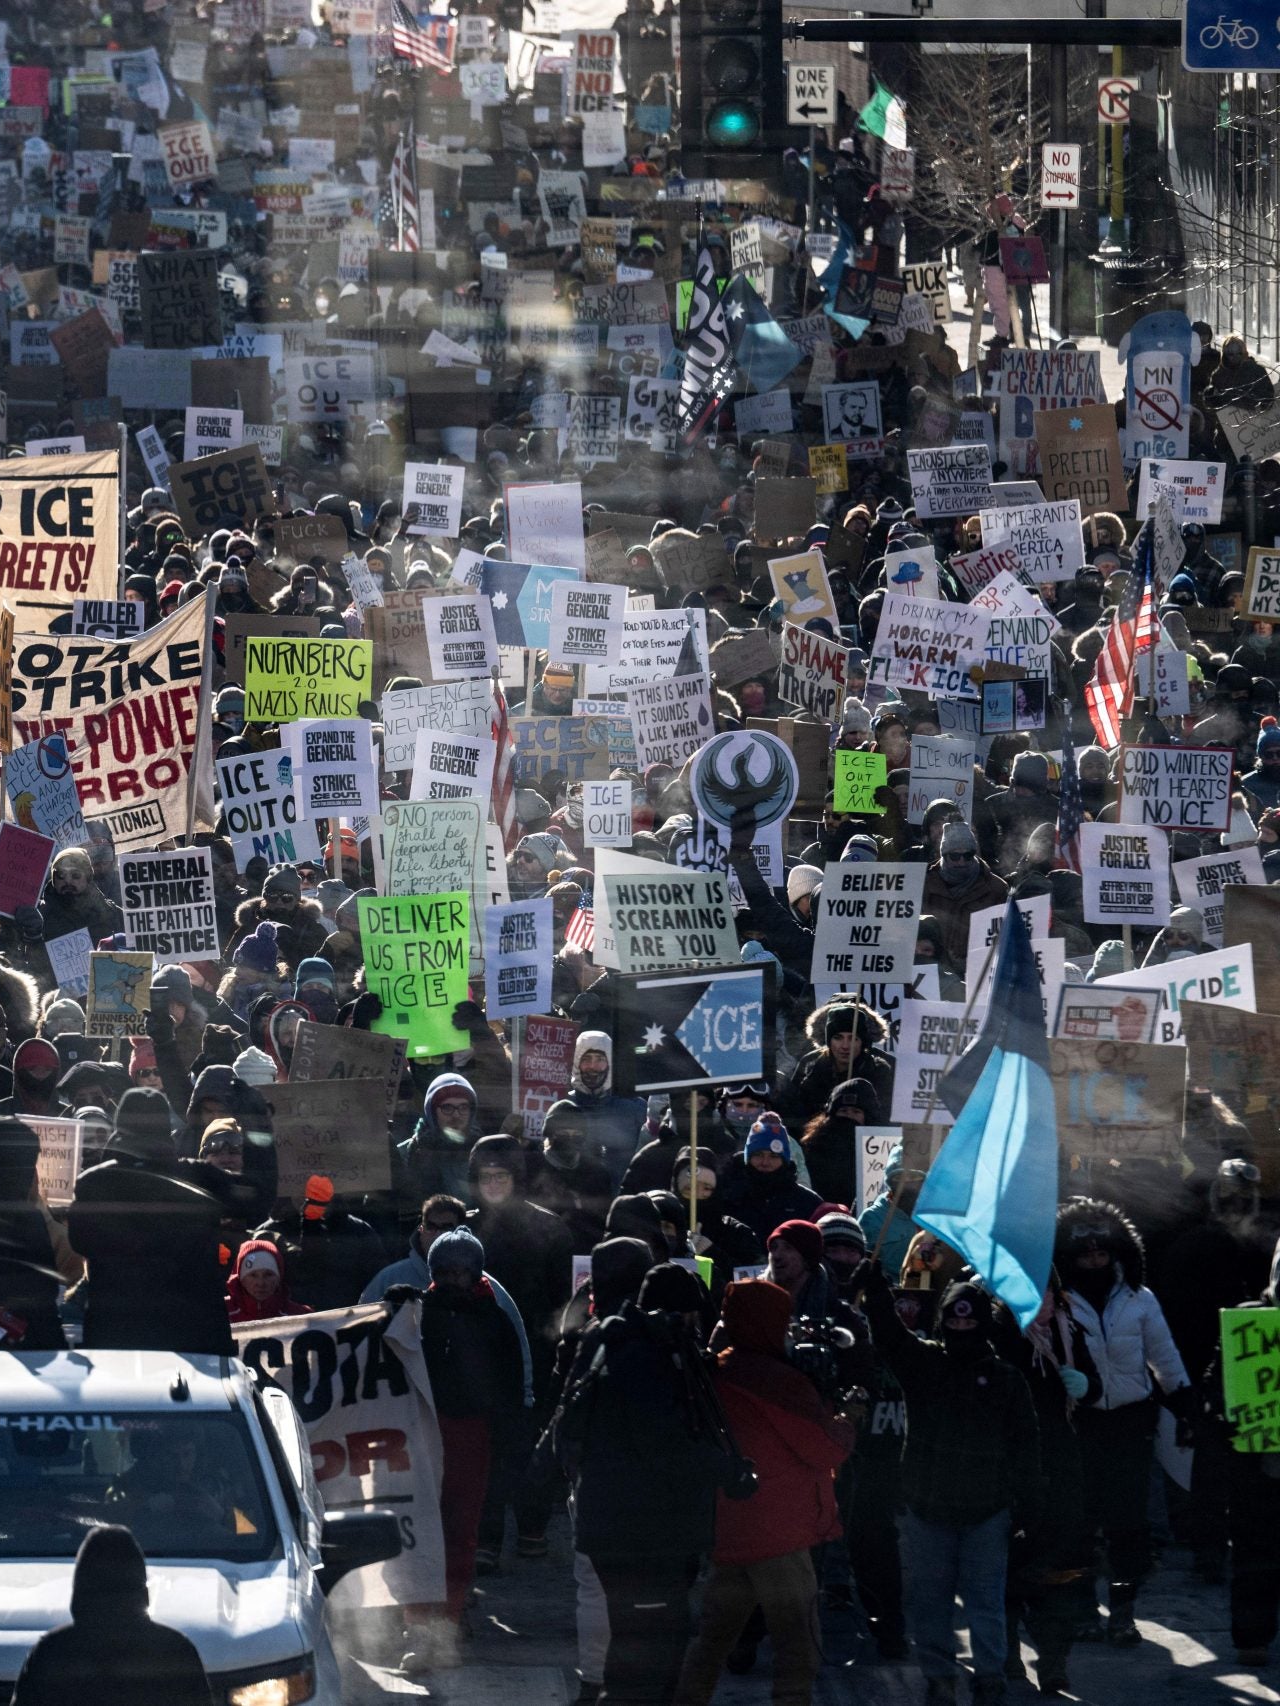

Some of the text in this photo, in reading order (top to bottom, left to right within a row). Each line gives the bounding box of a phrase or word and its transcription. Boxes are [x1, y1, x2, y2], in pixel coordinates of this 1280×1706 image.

[578, 34, 613, 56] NO
[577, 59, 612, 72] KINGS
[796, 69, 827, 84] ONE
[575, 72, 612, 93] NO
[795, 84, 828, 99] WAY
[165, 135, 202, 158] ICE
[171, 157, 209, 177] OUT!
[1052, 152, 1070, 166] NO
[1045, 172, 1077, 184] STOPPING
[732, 231, 749, 245] MN
[732, 241, 762, 263] PRETTI
[144, 259, 210, 283] WHAT
[902, 267, 946, 291] FUCK
[303, 360, 351, 380] ICE
[1002, 353, 1095, 371] MAKE AMERICA
[1007, 371, 1053, 394] GREAT
[1144, 366, 1172, 386] MN
[196, 425, 231, 438] GENERAL
[197, 416, 232, 426] EXPAND THE
[1049, 448, 1109, 476] PRETTI
[181, 456, 267, 505] ICE
[1053, 479, 1111, 506] GOOD
[20, 487, 94, 537] ICE
[983, 504, 1078, 529] IMMIGRANTS
[1011, 526, 1049, 543] MAKE
[567, 592, 612, 605] EXPAND THE
[82, 602, 138, 626] KILLER
[440, 604, 477, 620] JUSTICE
[566, 603, 610, 620] GENERAL
[440, 618, 481, 634] FOR ALEX
[567, 627, 606, 643] STRIKE!
[888, 624, 974, 650] HORCHATA
[248, 641, 367, 681] NÜRNBERG
[444, 652, 463, 662] KILLED
[785, 627, 847, 684] SHAME
[894, 641, 958, 666] WARM
[294, 677, 317, 688] 2.0
[805, 668, 821, 683] ON
[932, 667, 976, 693] ICE
[677, 679, 704, 698] WHAT
[248, 690, 362, 717] NAZIS RAUS!
[650, 702, 689, 722] SOUNDS
[645, 744, 680, 763] DOVES
[1123, 750, 1229, 777] COLD WINTERS
[222, 760, 269, 797] ICE
[1123, 776, 1227, 800] WARM HEARTS
[590, 784, 623, 806] ICE
[431, 807, 474, 821] person
[588, 811, 631, 836] OUT!!
[1143, 800, 1215, 826] NO ICE
[253, 830, 297, 865] MN
[1101, 835, 1148, 853] JUSTICE
[123, 856, 209, 884] GENERAL
[1100, 850, 1151, 870] FOR ALEX
[841, 873, 905, 892] BELIEVE
[125, 880, 211, 909] STRIKE:
[616, 882, 722, 906] HISTORY IS
[127, 905, 214, 933] THE PATH TO
[367, 900, 466, 934] DELIVER
[826, 900, 914, 919] YOUR EYES
[615, 909, 727, 933] SCREAMING
[126, 928, 217, 955] JUSTICE
[630, 933, 716, 957] ARE YOU
[850, 926, 880, 944] NOT
[369, 937, 464, 971] US FROM
[826, 953, 895, 973] THE LIES
[379, 972, 448, 1009] ICE
[528, 1023, 574, 1044] SALT THE
[701, 1005, 762, 1048] ICE
